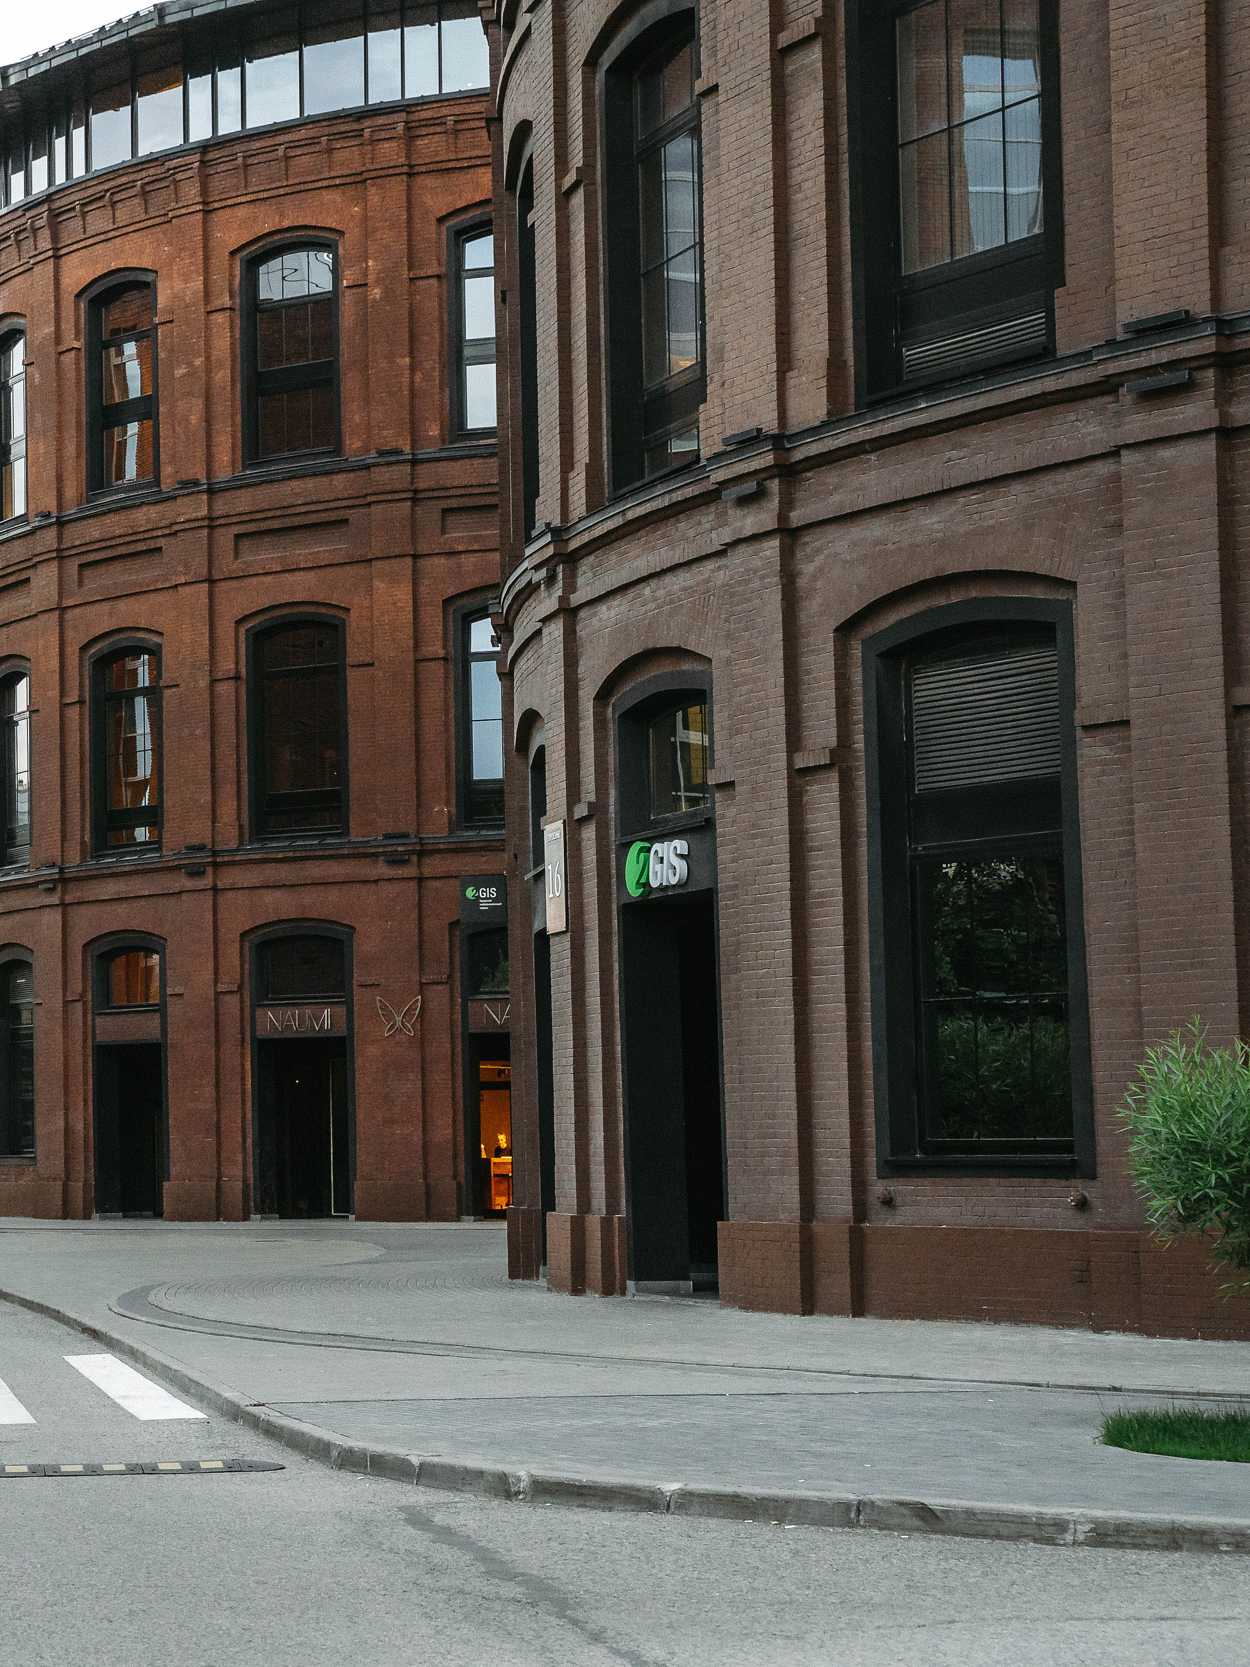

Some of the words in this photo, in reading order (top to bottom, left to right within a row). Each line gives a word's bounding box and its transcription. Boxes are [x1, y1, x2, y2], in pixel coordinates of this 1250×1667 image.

[548, 861, 561, 898] 16
[625, 840, 689, 897] 2GIS
[466, 887, 497, 899] 2GIS
[267, 1008, 331, 1031] NAUMI
